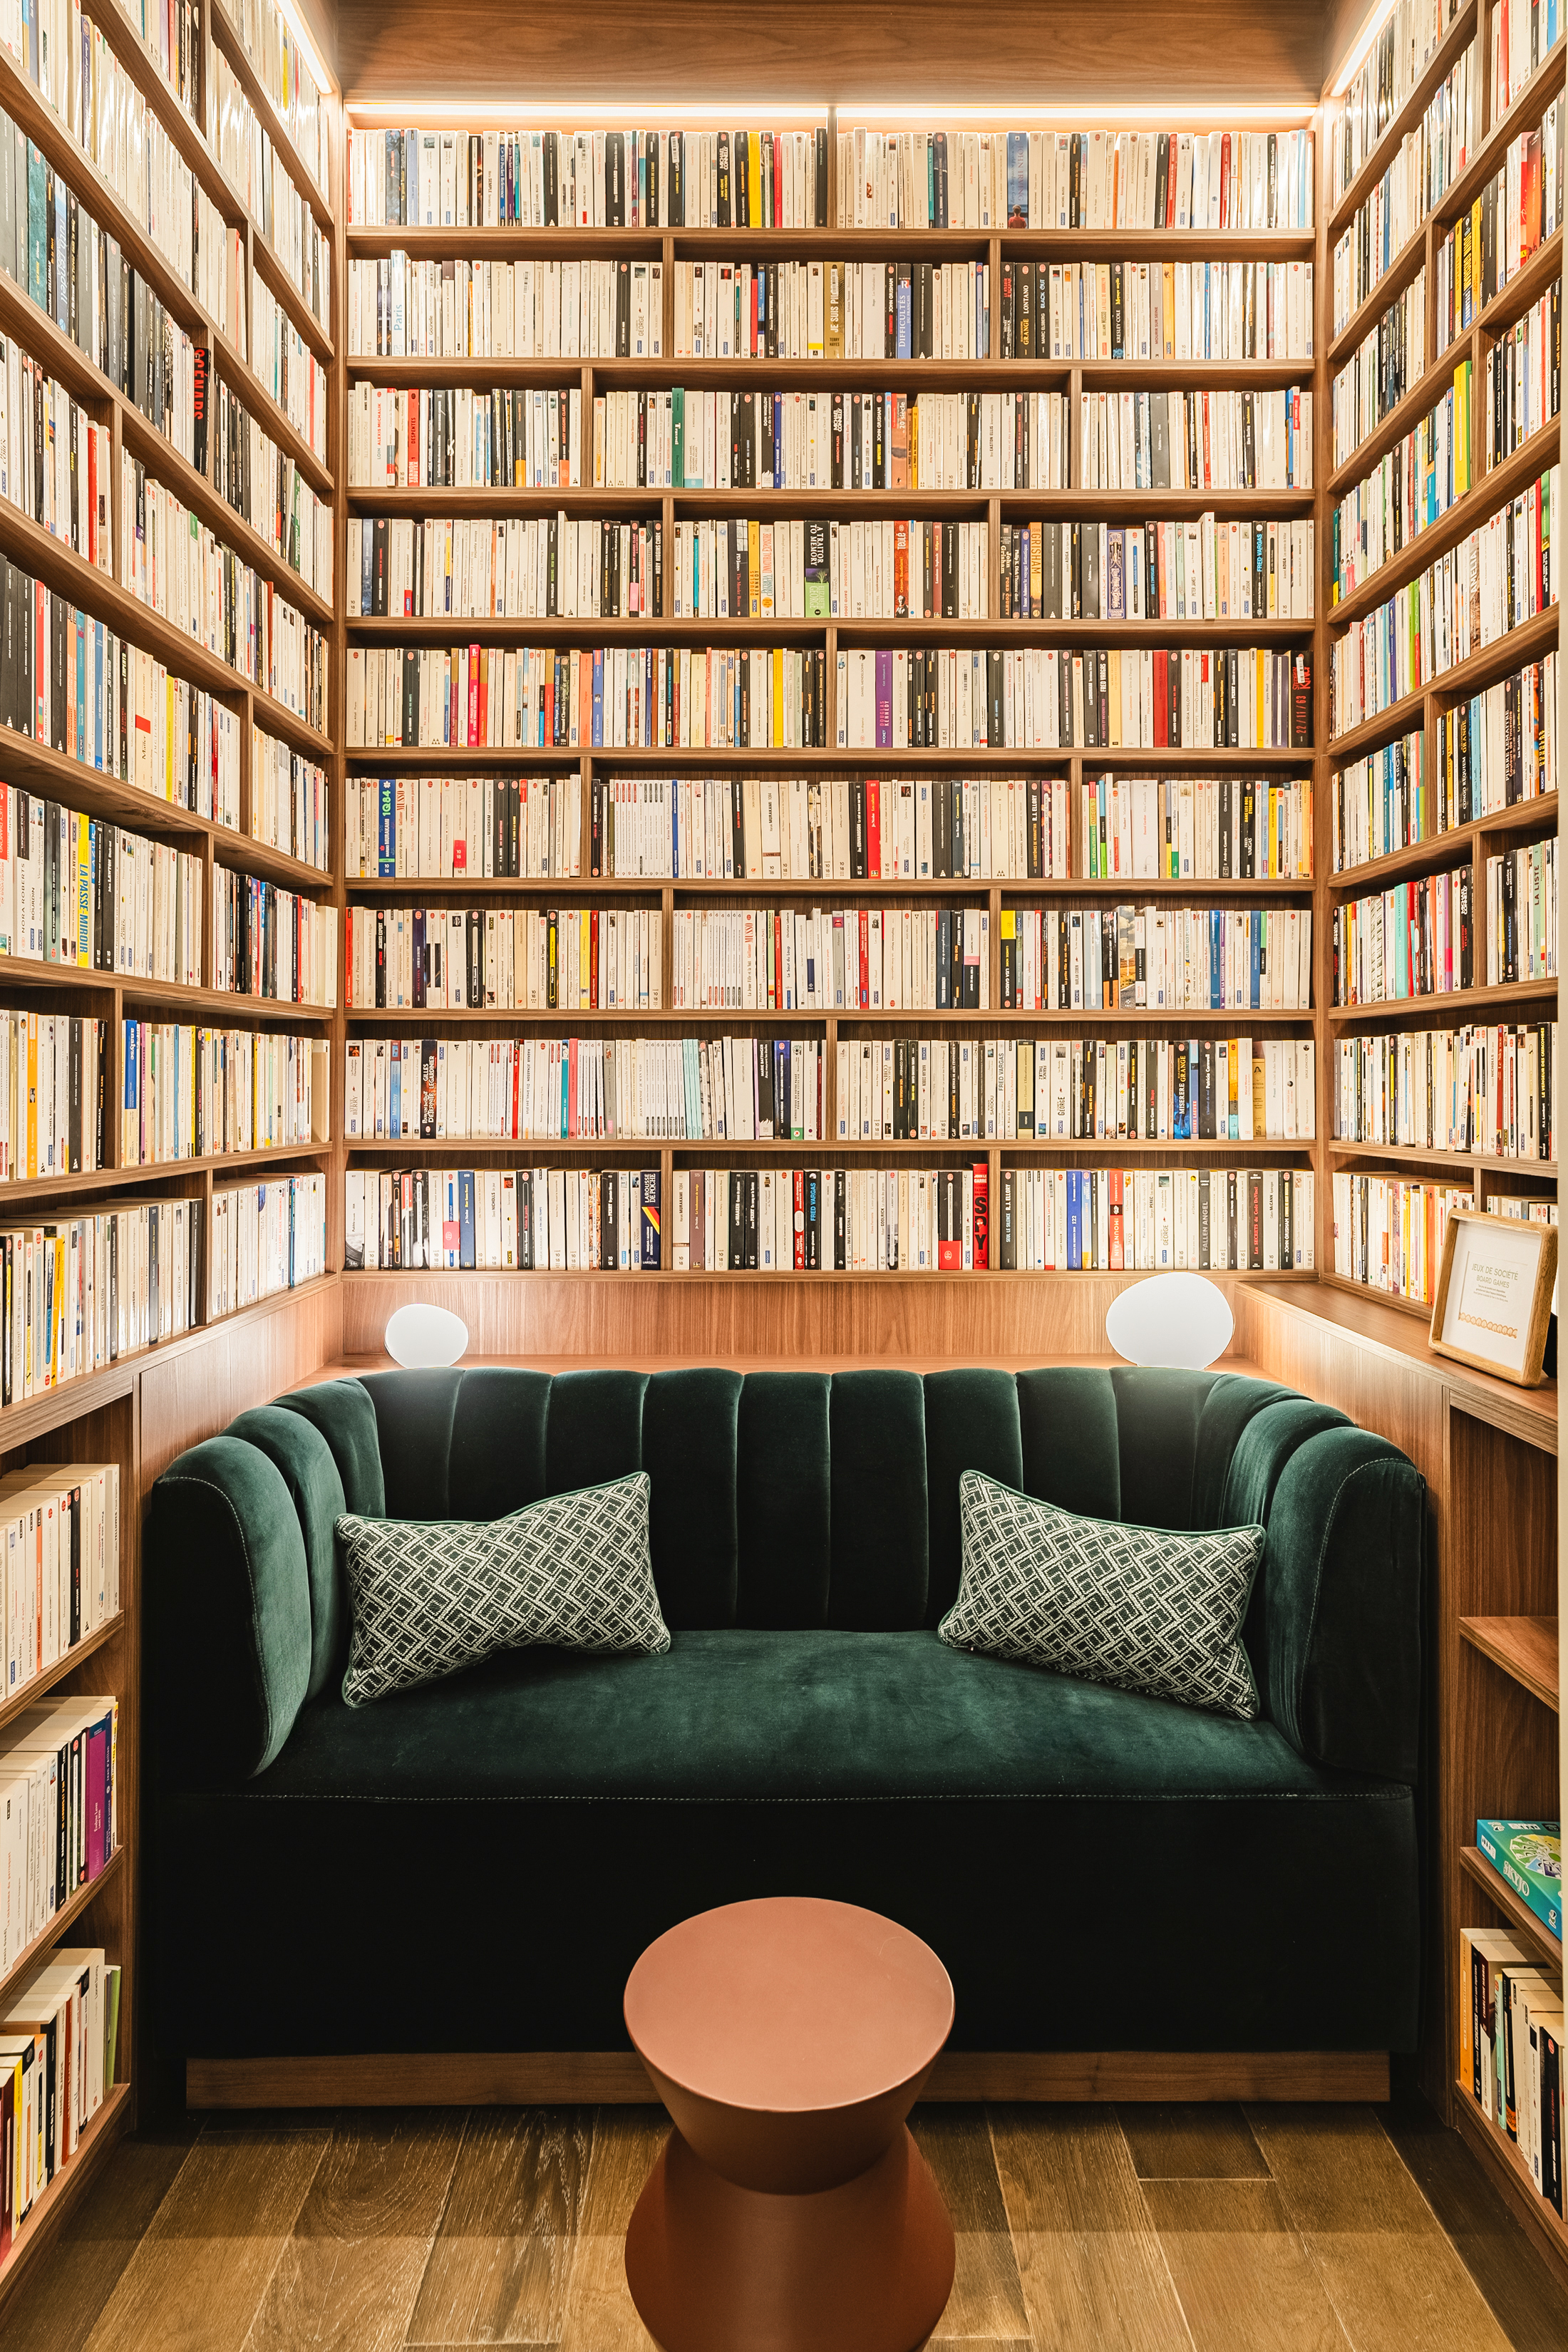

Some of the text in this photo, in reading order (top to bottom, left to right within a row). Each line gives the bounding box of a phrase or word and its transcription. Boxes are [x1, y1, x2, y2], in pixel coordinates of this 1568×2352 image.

[393, 305, 402, 330] Paris
[810, 524, 817, 534] TO
[1470, 550, 1479, 594] AMELIA
[382, 790, 391, 816] 1Q84
[80, 864, 88, 876] LA
[1535, 894, 1539, 905] LA
[1472, 1264, 1484, 1273] JEUX
[1494, 1269, 1518, 1280] SOCIÉTÉ
[1477, 1275, 1510, 1289] BOARD GAMES
[1503, 1860, 1530, 1897] SKYJO
